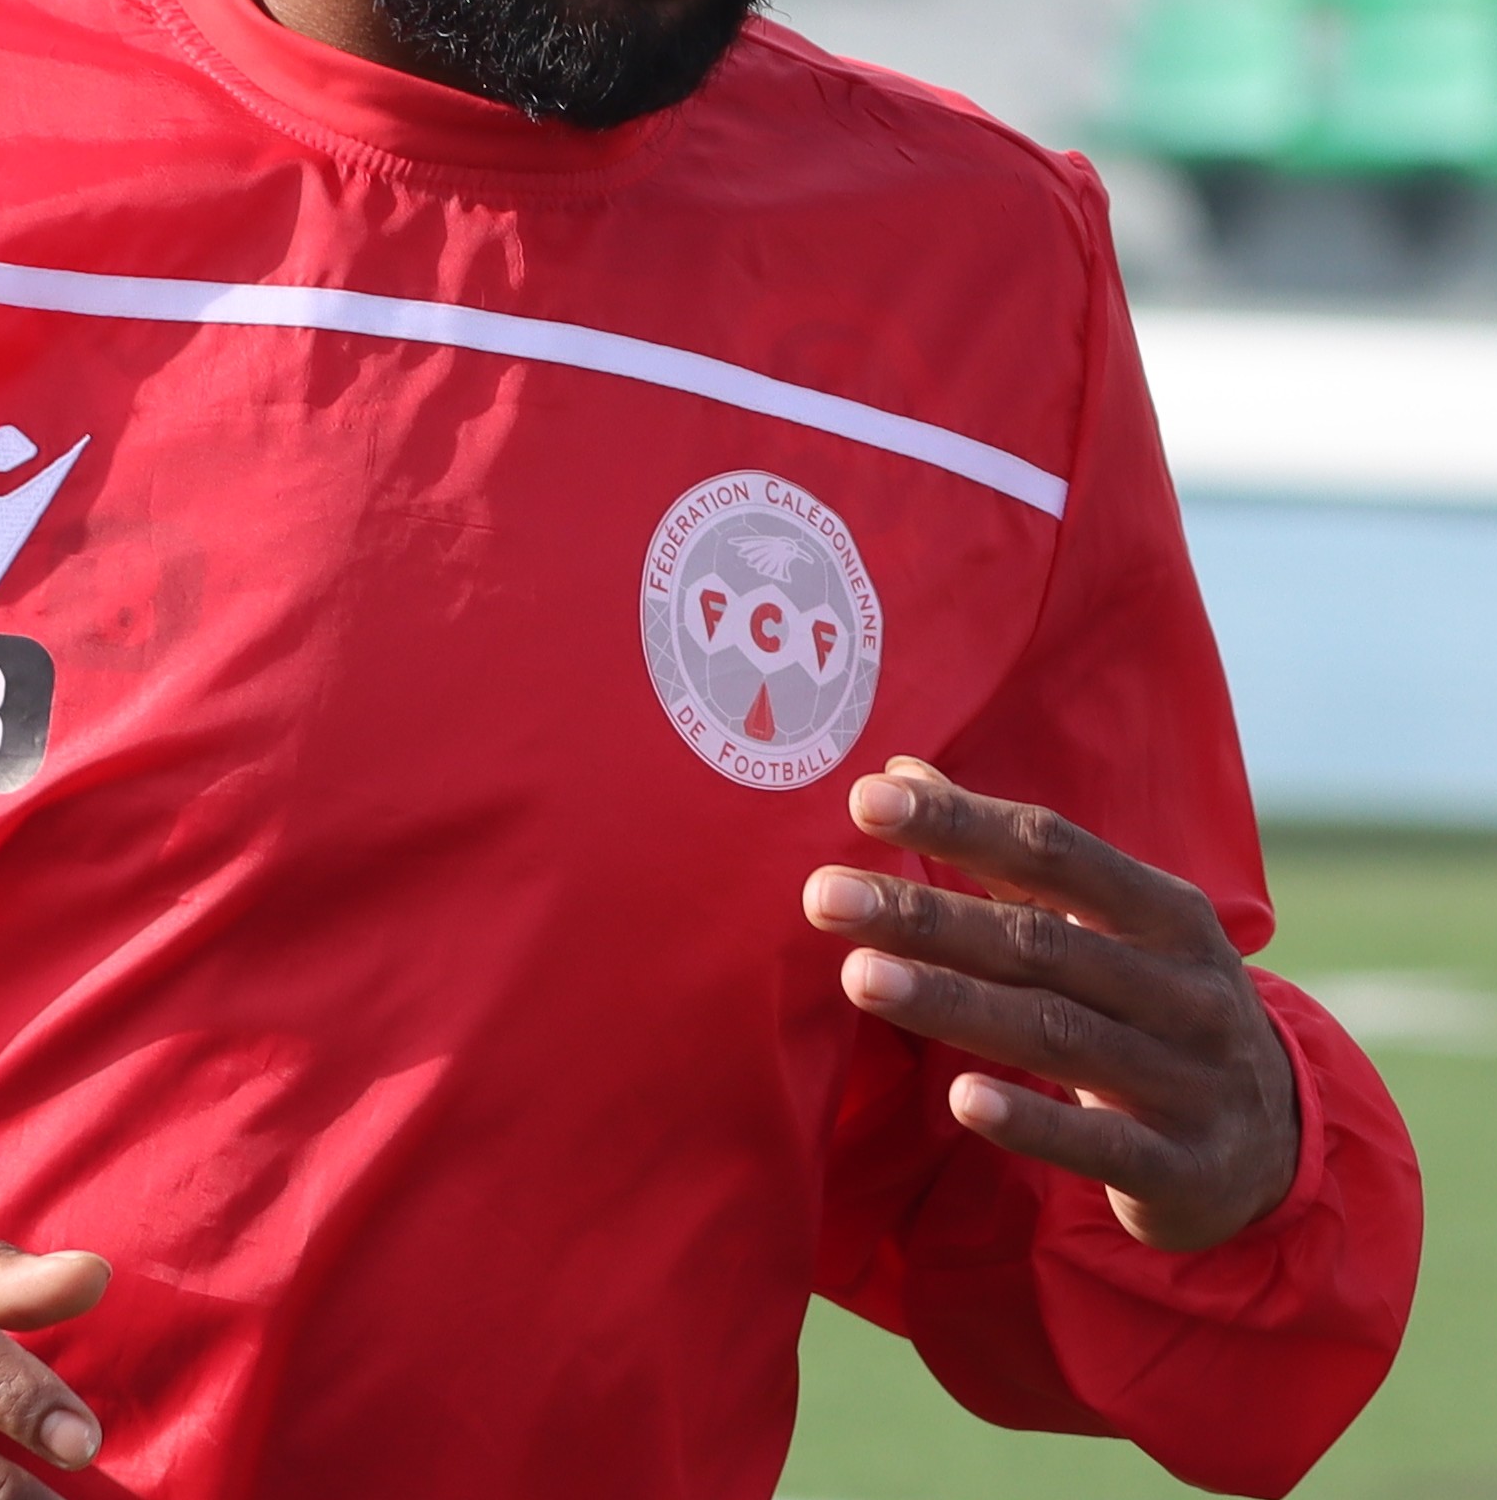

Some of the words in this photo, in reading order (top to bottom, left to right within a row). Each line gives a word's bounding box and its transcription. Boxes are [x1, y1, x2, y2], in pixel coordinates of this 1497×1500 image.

[650, 481, 750, 593] FÉDÉRATION
[765, 480, 876, 650] CALÉDONIENNE
[676, 704, 706, 742] DE
[717, 742, 832, 782] FOOTBALL
